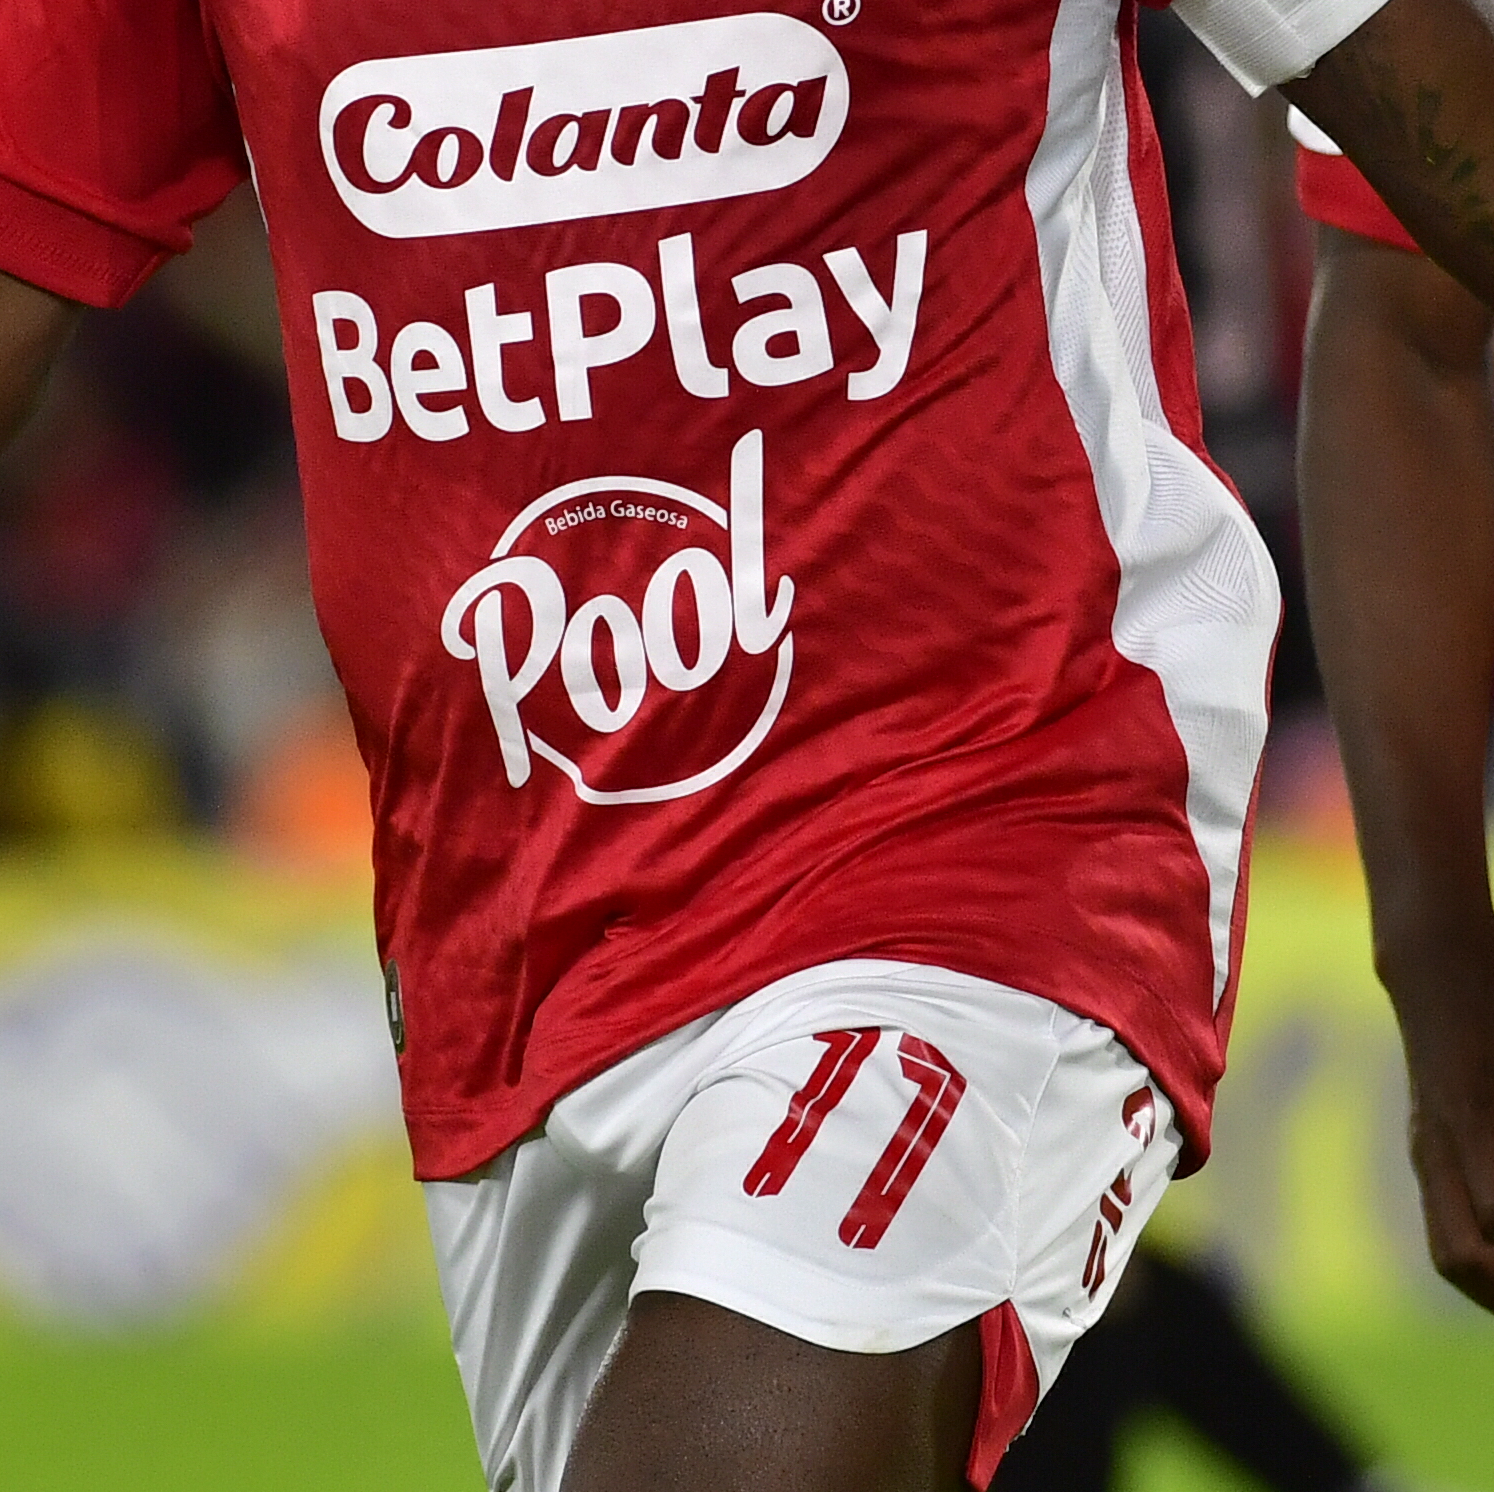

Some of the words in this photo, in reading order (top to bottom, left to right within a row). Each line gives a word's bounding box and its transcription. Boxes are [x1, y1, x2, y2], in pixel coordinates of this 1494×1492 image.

[333, 65, 828, 194] Colanta
[312, 229, 929, 444] BetPlay
[441, 429, 795, 789] Pool
[544, 501, 606, 536] Bebida
[610, 499, 689, 530] Gaseosa
[742, 1026, 967, 1250] 11
